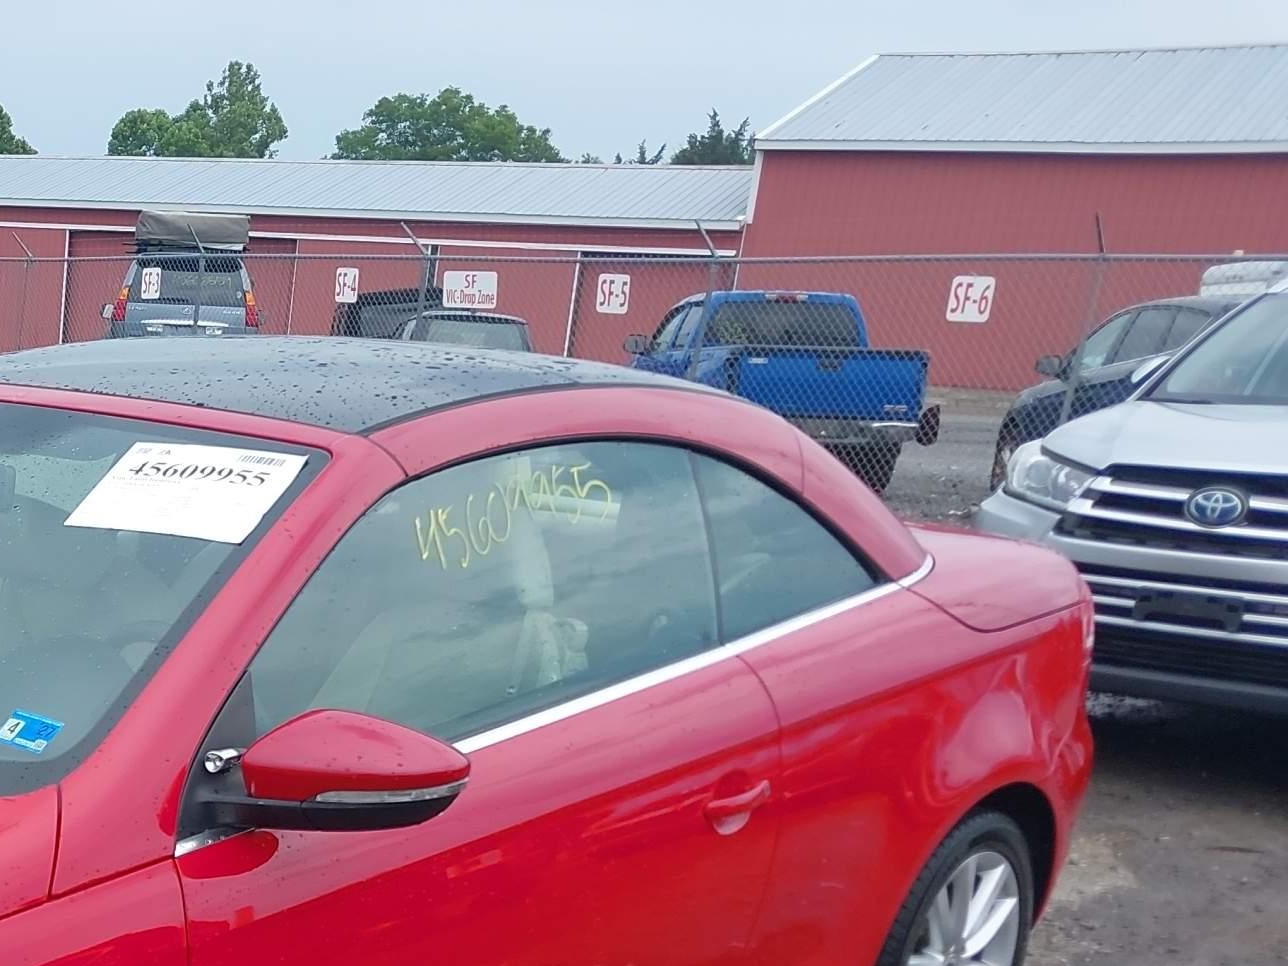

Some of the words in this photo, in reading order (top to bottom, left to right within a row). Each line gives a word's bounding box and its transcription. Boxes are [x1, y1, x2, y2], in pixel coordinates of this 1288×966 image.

[143, 271, 160, 294] SF-3
[336, 272, 357, 297] SF-4
[464, 274, 478, 289] SF
[599, 279, 628, 307] SF-5
[477, 289, 495, 304] Zone
[949, 281, 991, 315] SF-6
[129, 460, 272, 487] 45609955
[7, 721, 21, 735] 4
